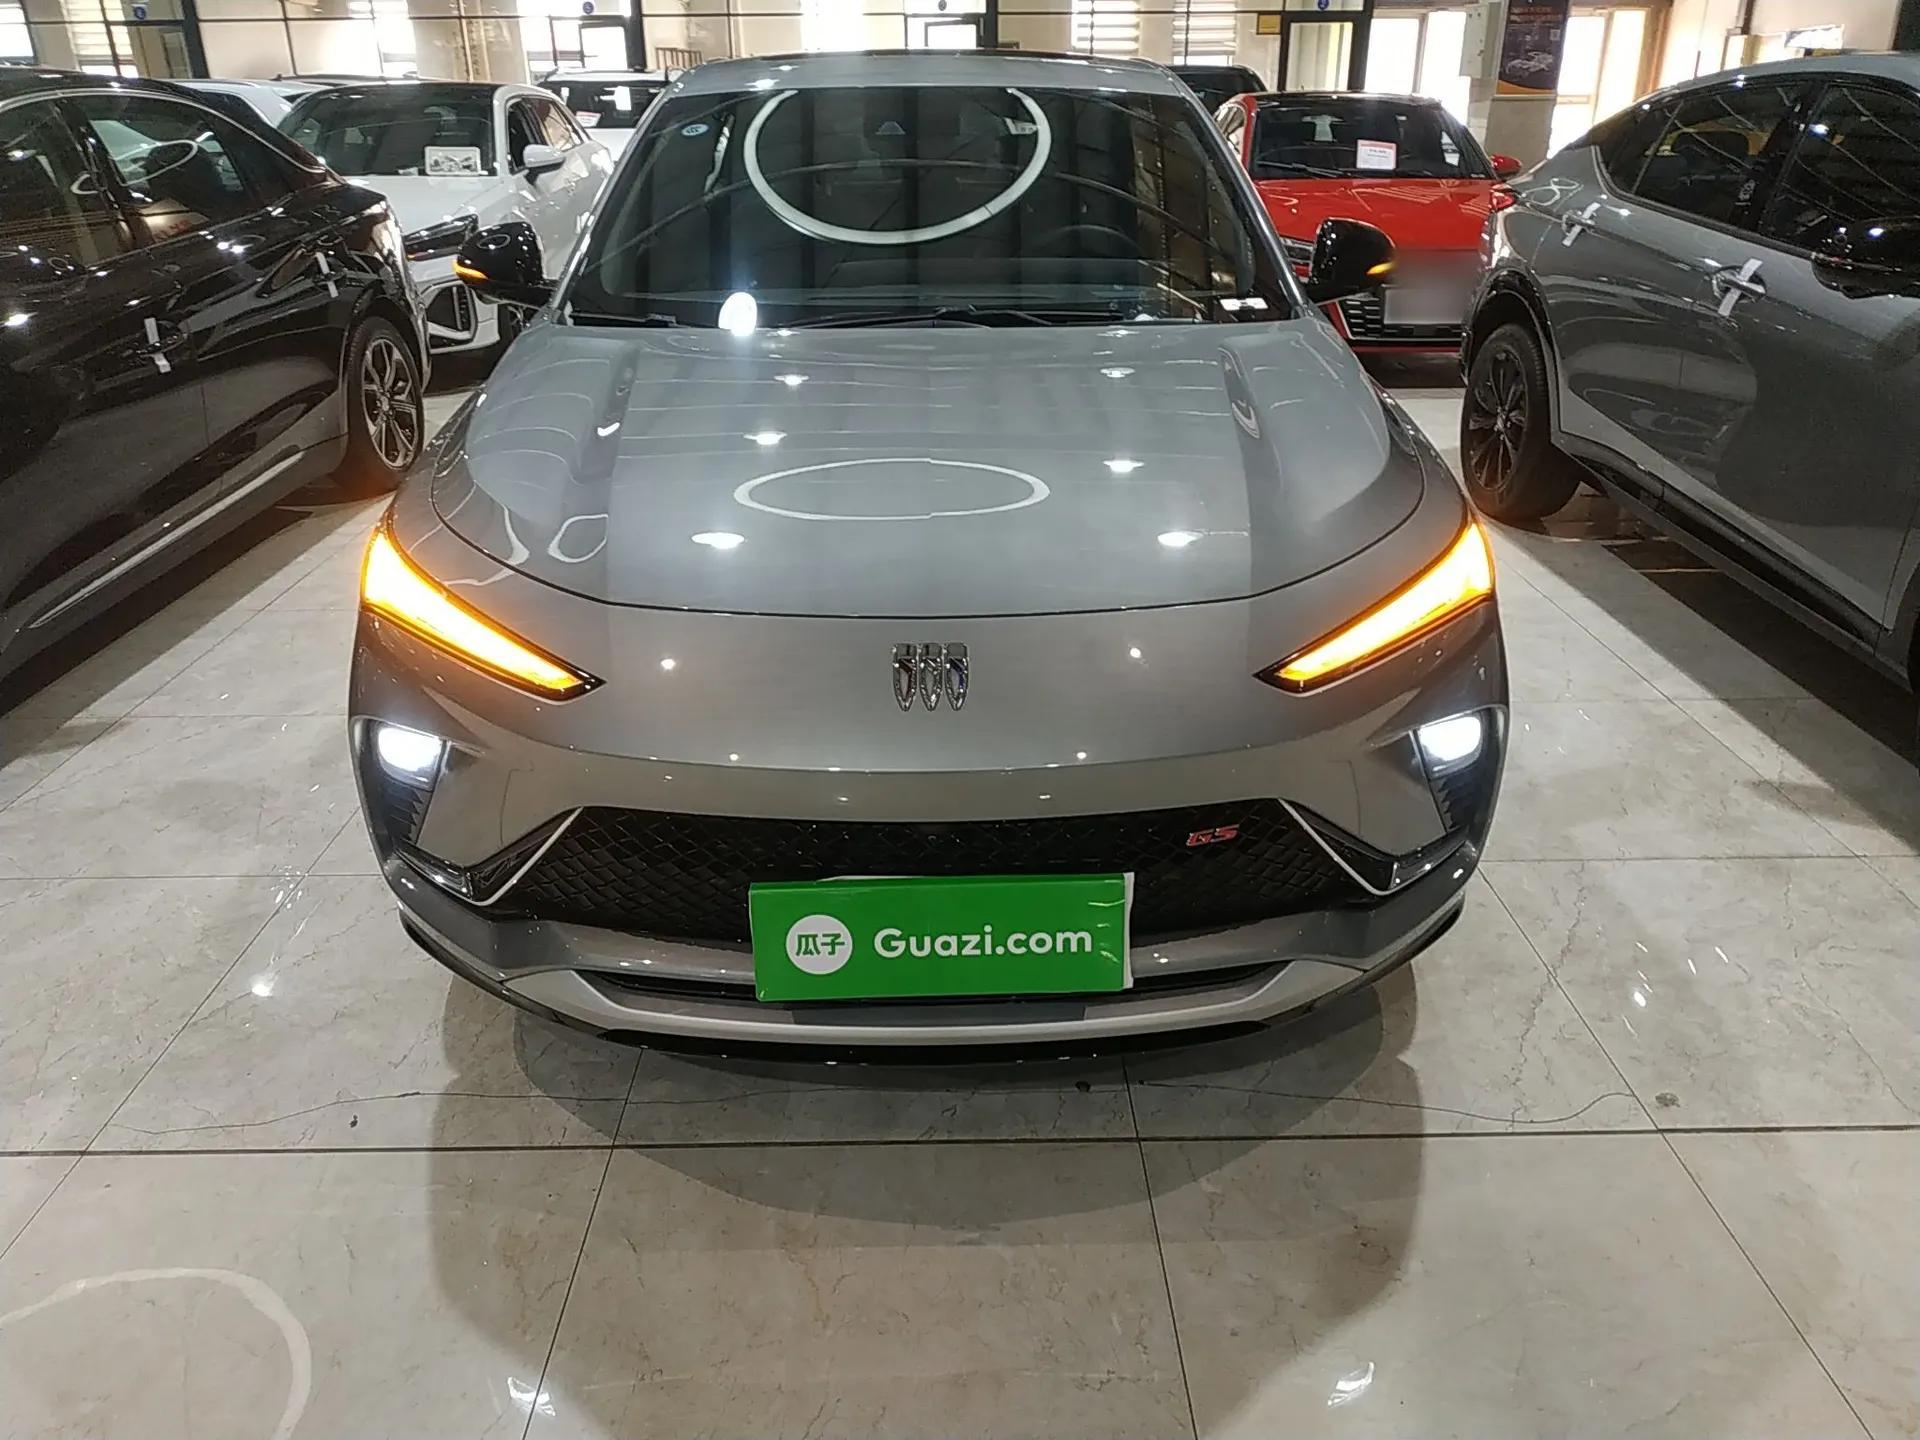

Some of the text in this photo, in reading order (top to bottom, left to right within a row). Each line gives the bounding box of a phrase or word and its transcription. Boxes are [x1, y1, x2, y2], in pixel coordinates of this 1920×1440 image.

[1186, 824, 1239, 846] GS
[796, 933, 845, 956] 瓜子
[874, 925, 1092, 958] Guazi.com
